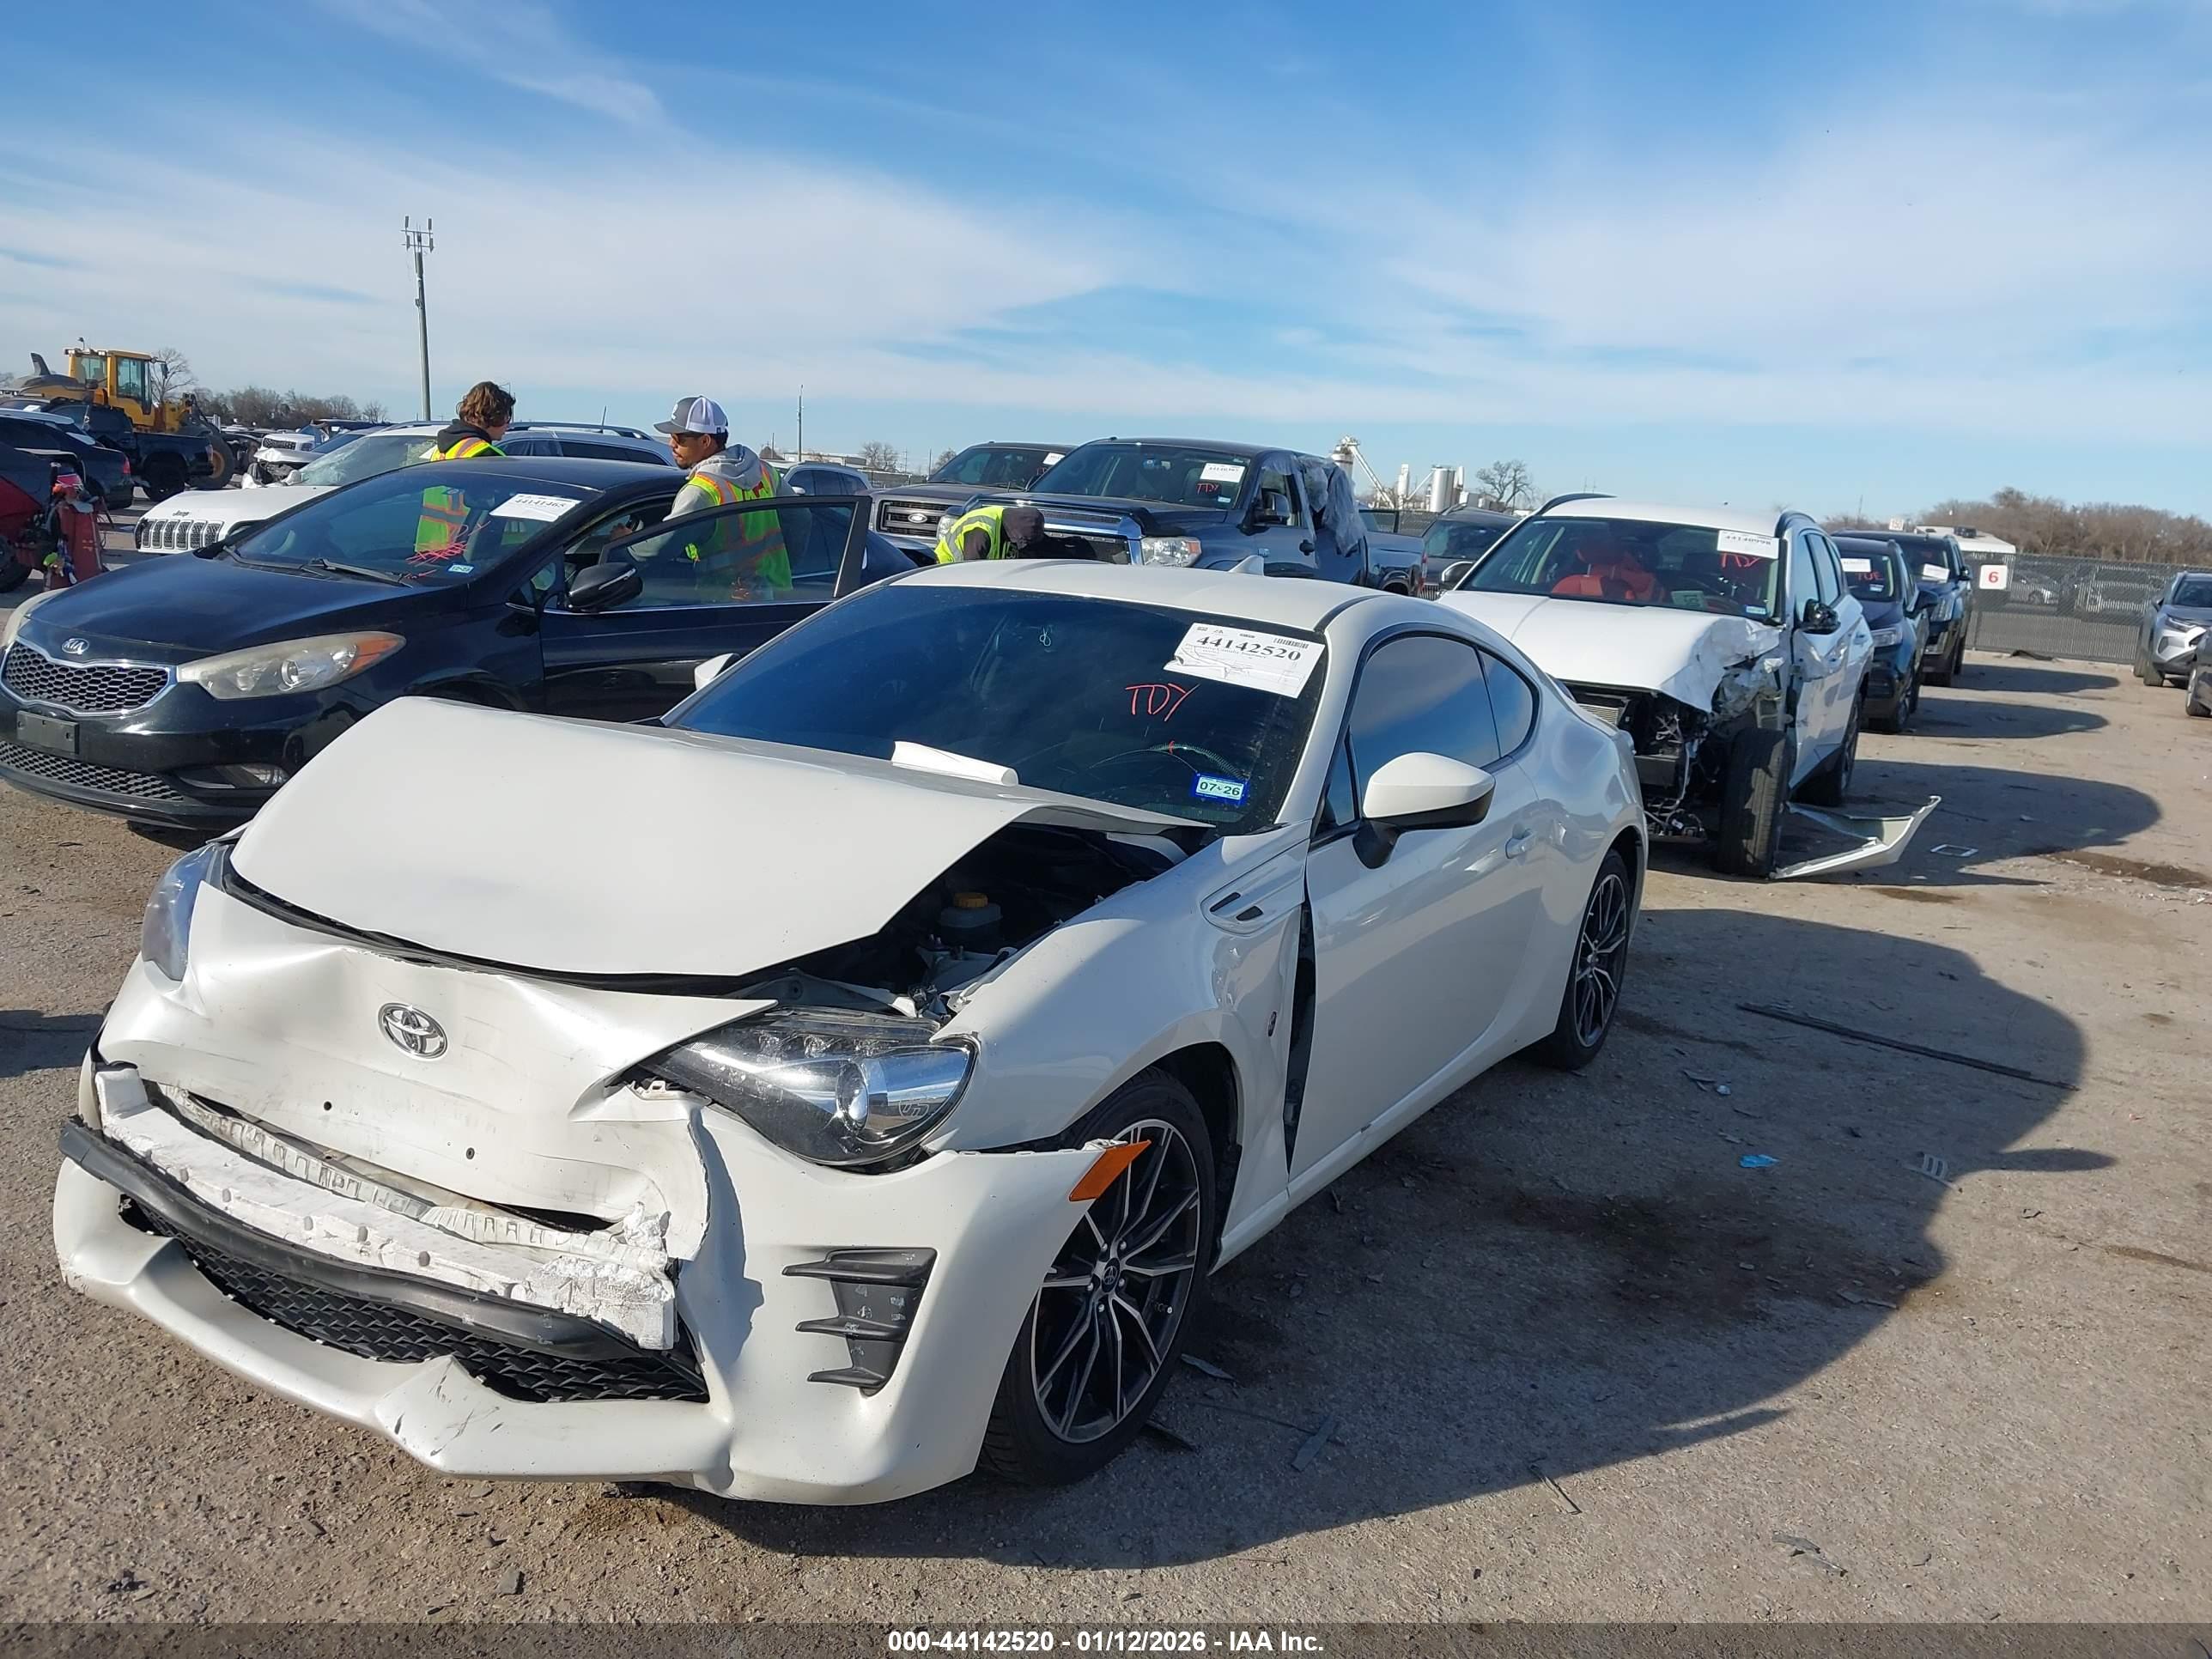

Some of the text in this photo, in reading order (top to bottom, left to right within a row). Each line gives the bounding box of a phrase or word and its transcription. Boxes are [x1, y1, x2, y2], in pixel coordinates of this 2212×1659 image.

[1988, 571, 1999, 583] 6
[64, 640, 85, 655] KIA
[1197, 635, 1302, 662] 44142520
[1125, 682, 1200, 722] TDY
[1200, 781, 1217, 792] 07
[1223, 785, 1241, 797] 26
